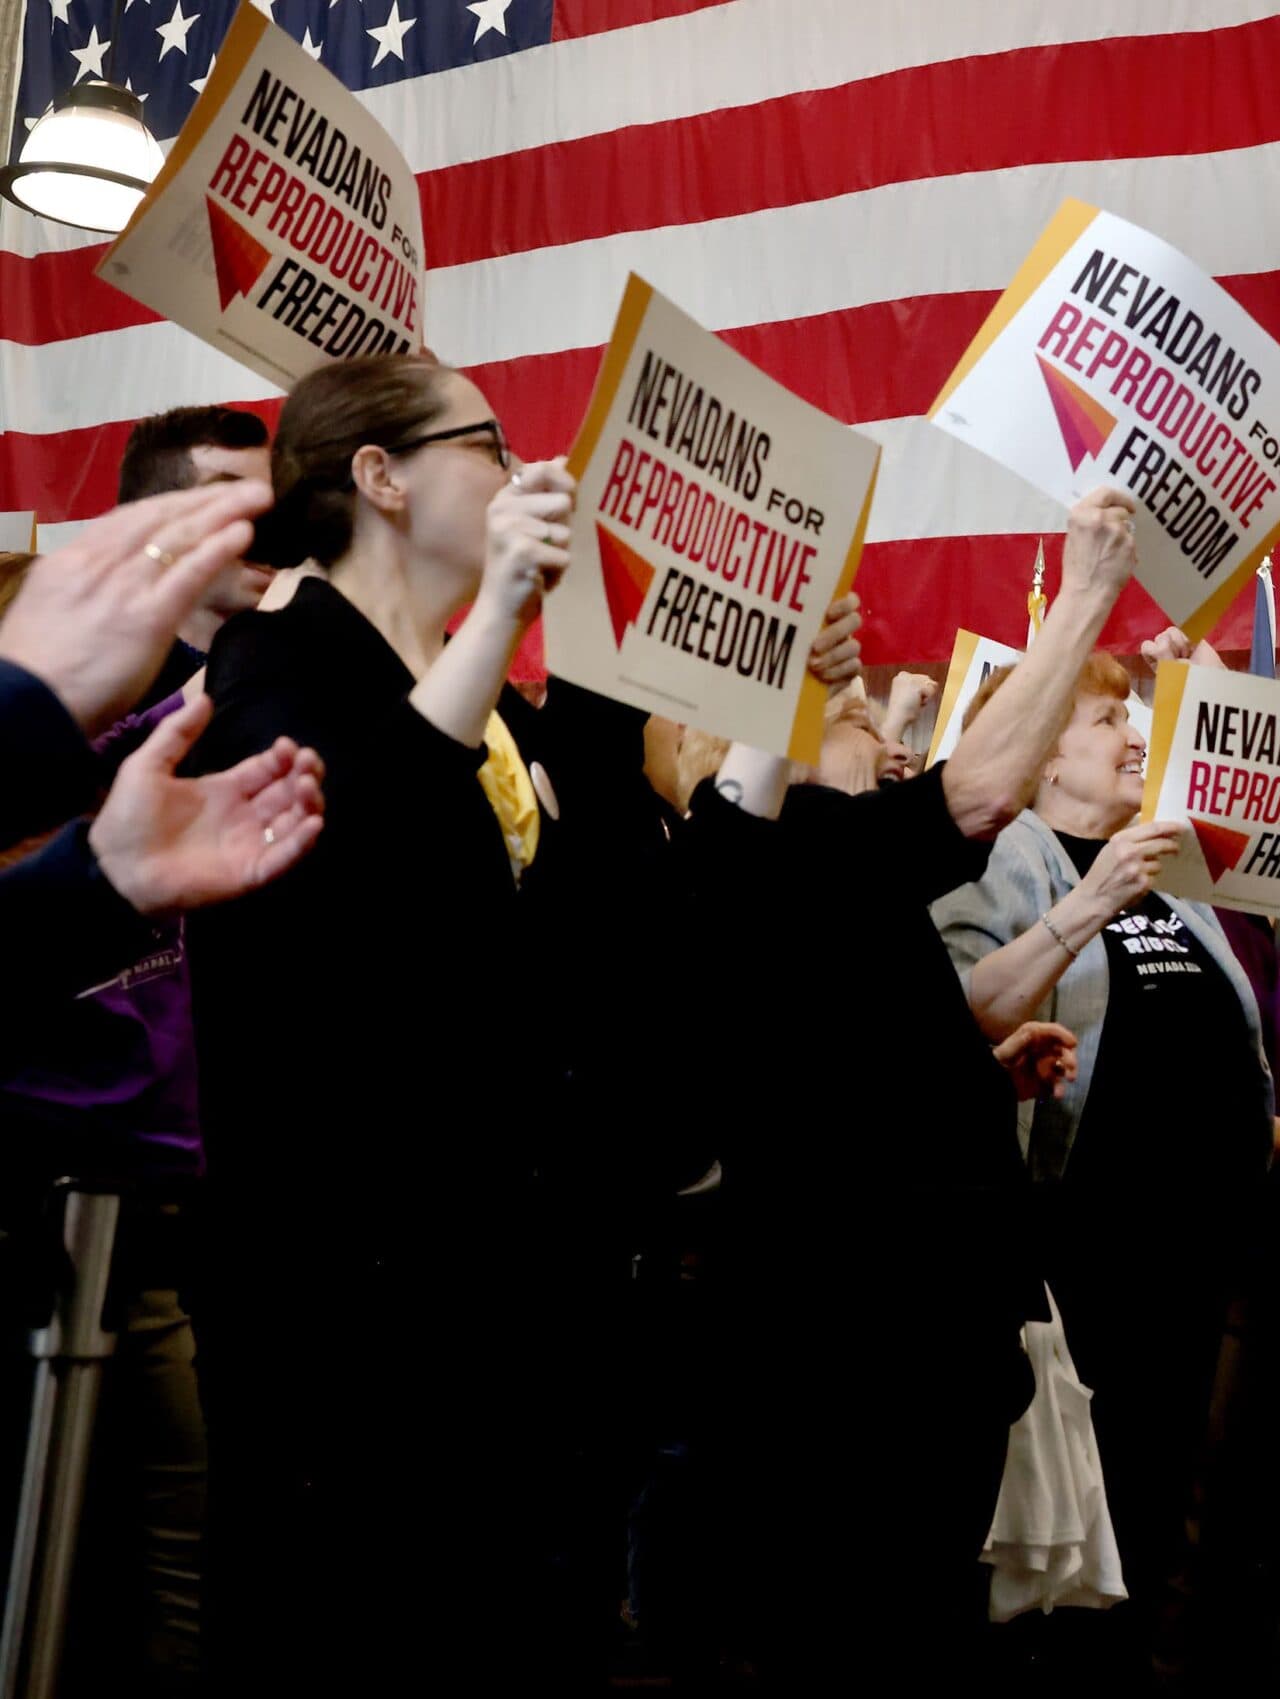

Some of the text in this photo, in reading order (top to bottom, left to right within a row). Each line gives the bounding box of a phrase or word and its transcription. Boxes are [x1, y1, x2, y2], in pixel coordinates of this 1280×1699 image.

[209, 134, 417, 332] REPRODUCTIVE
[241, 69, 392, 230] NEVADANS
[1037, 301, 1277, 529] REPRODUCTIVE
[1070, 249, 1261, 421] NEVADANS
[599, 438, 818, 613] REPRODUCTIVE
[627, 350, 825, 536] NEVADANS FOR
[1109, 426, 1240, 580] FREEDOM
[646, 568, 797, 690] FREEDOM
